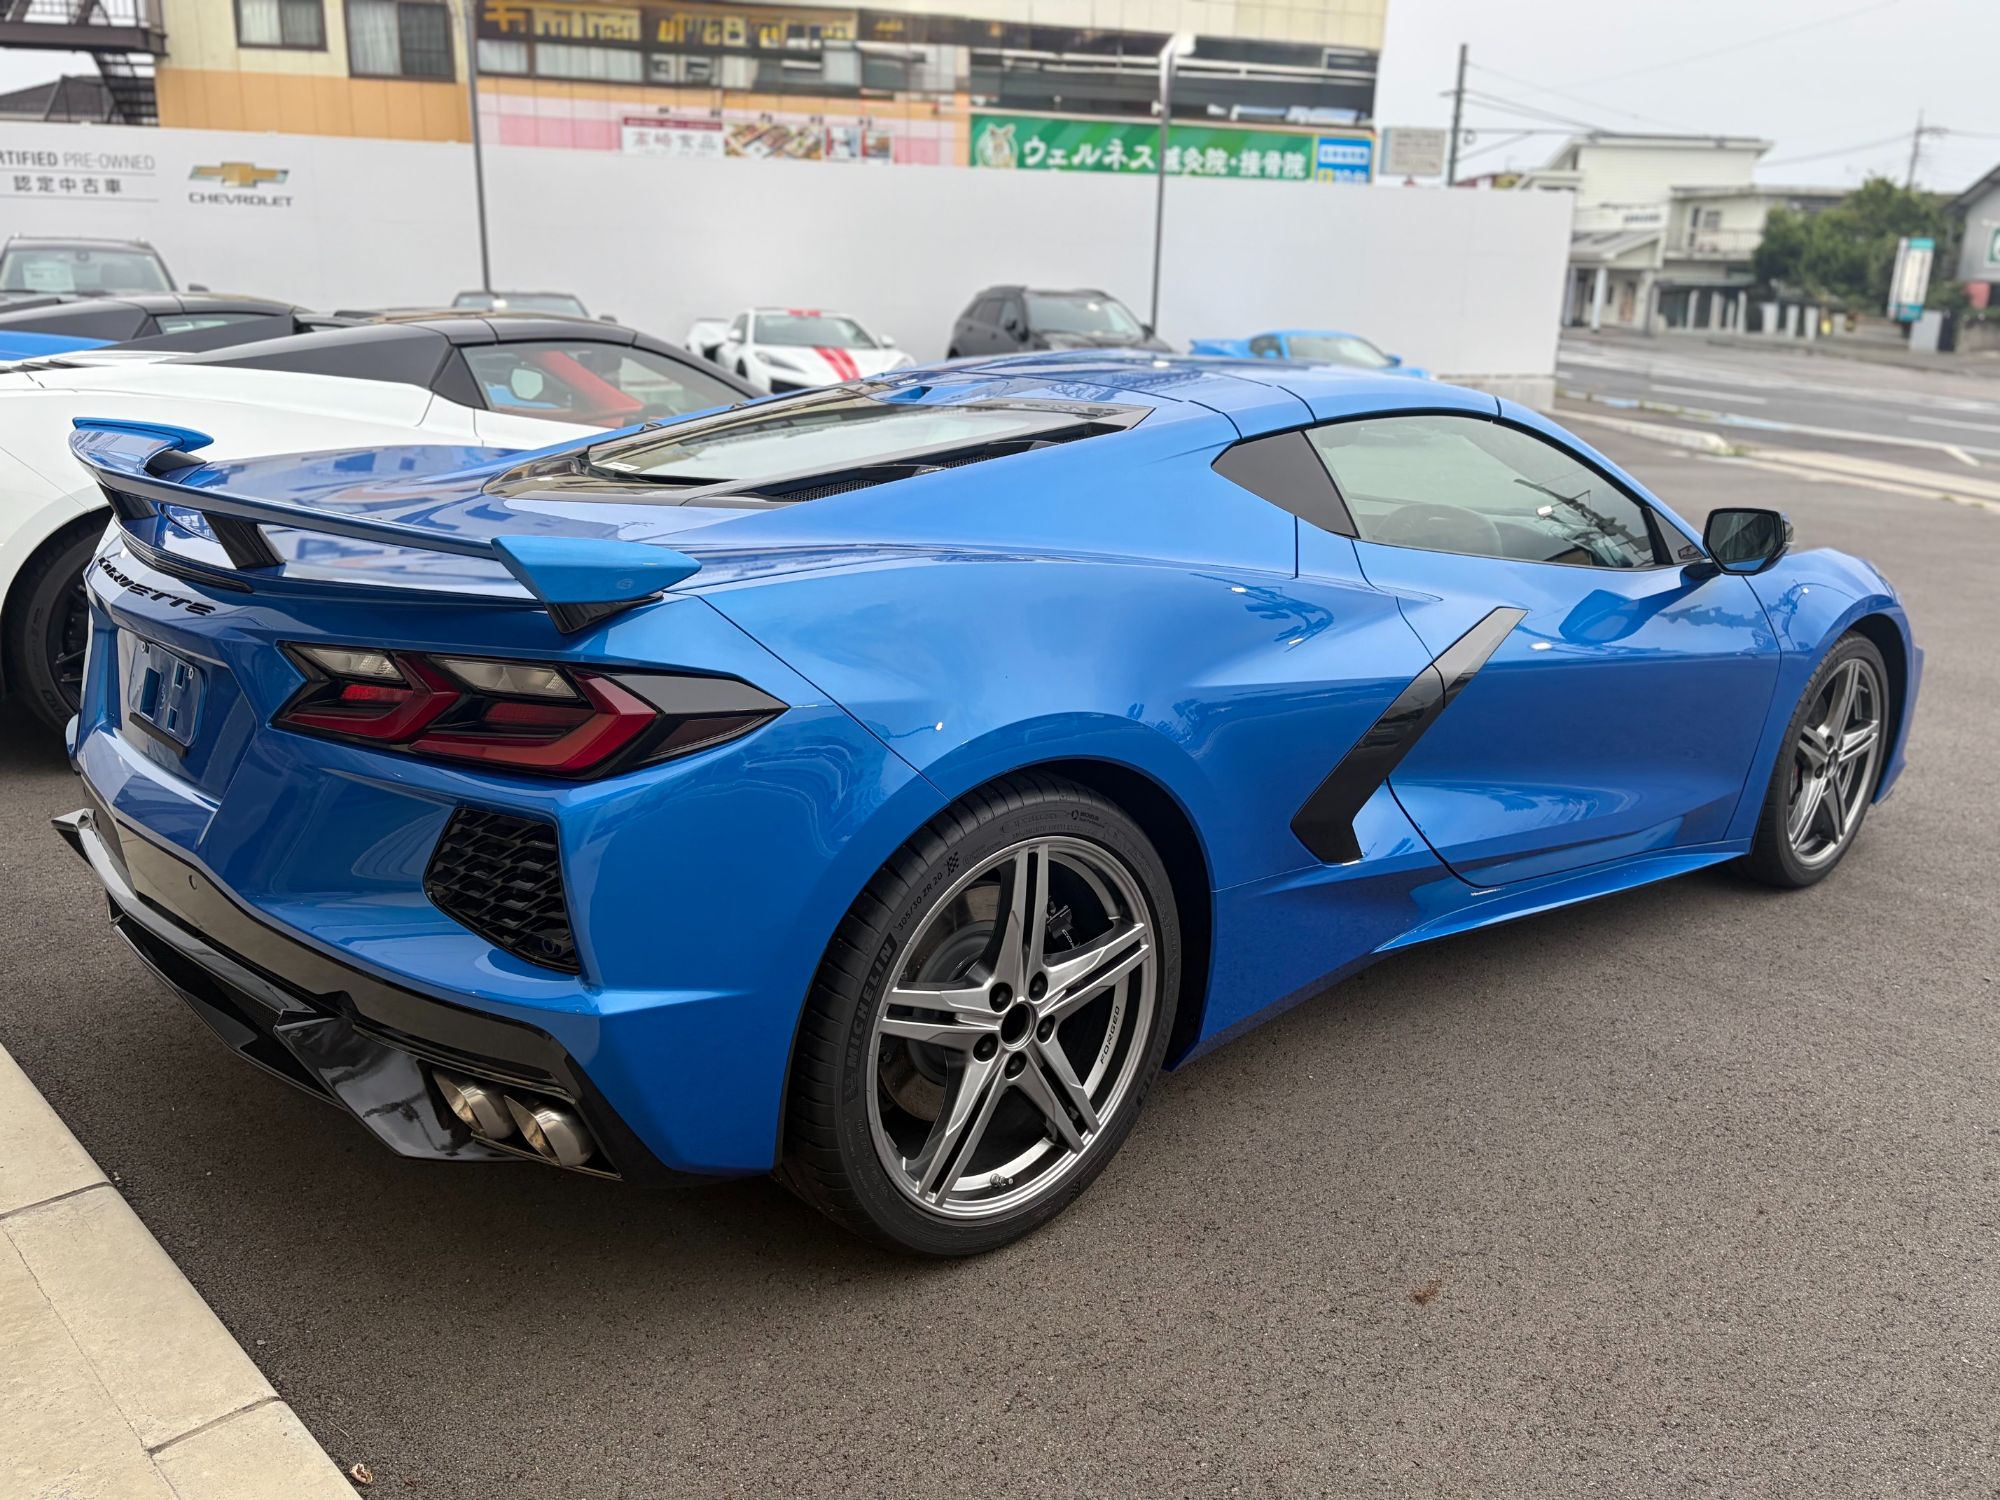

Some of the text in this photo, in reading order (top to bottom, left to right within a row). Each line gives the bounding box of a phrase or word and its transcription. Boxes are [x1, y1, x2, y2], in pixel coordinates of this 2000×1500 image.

[63, 152, 156, 171] PRE-OWNED
[13, 175, 121, 194] 認定中古車
[188, 192, 294, 207] CHEVROLET
[933, 872, 943, 885] 20
[847, 942, 891, 1067] MICHELIN
[1100, 1006, 1120, 1064] FORGED
